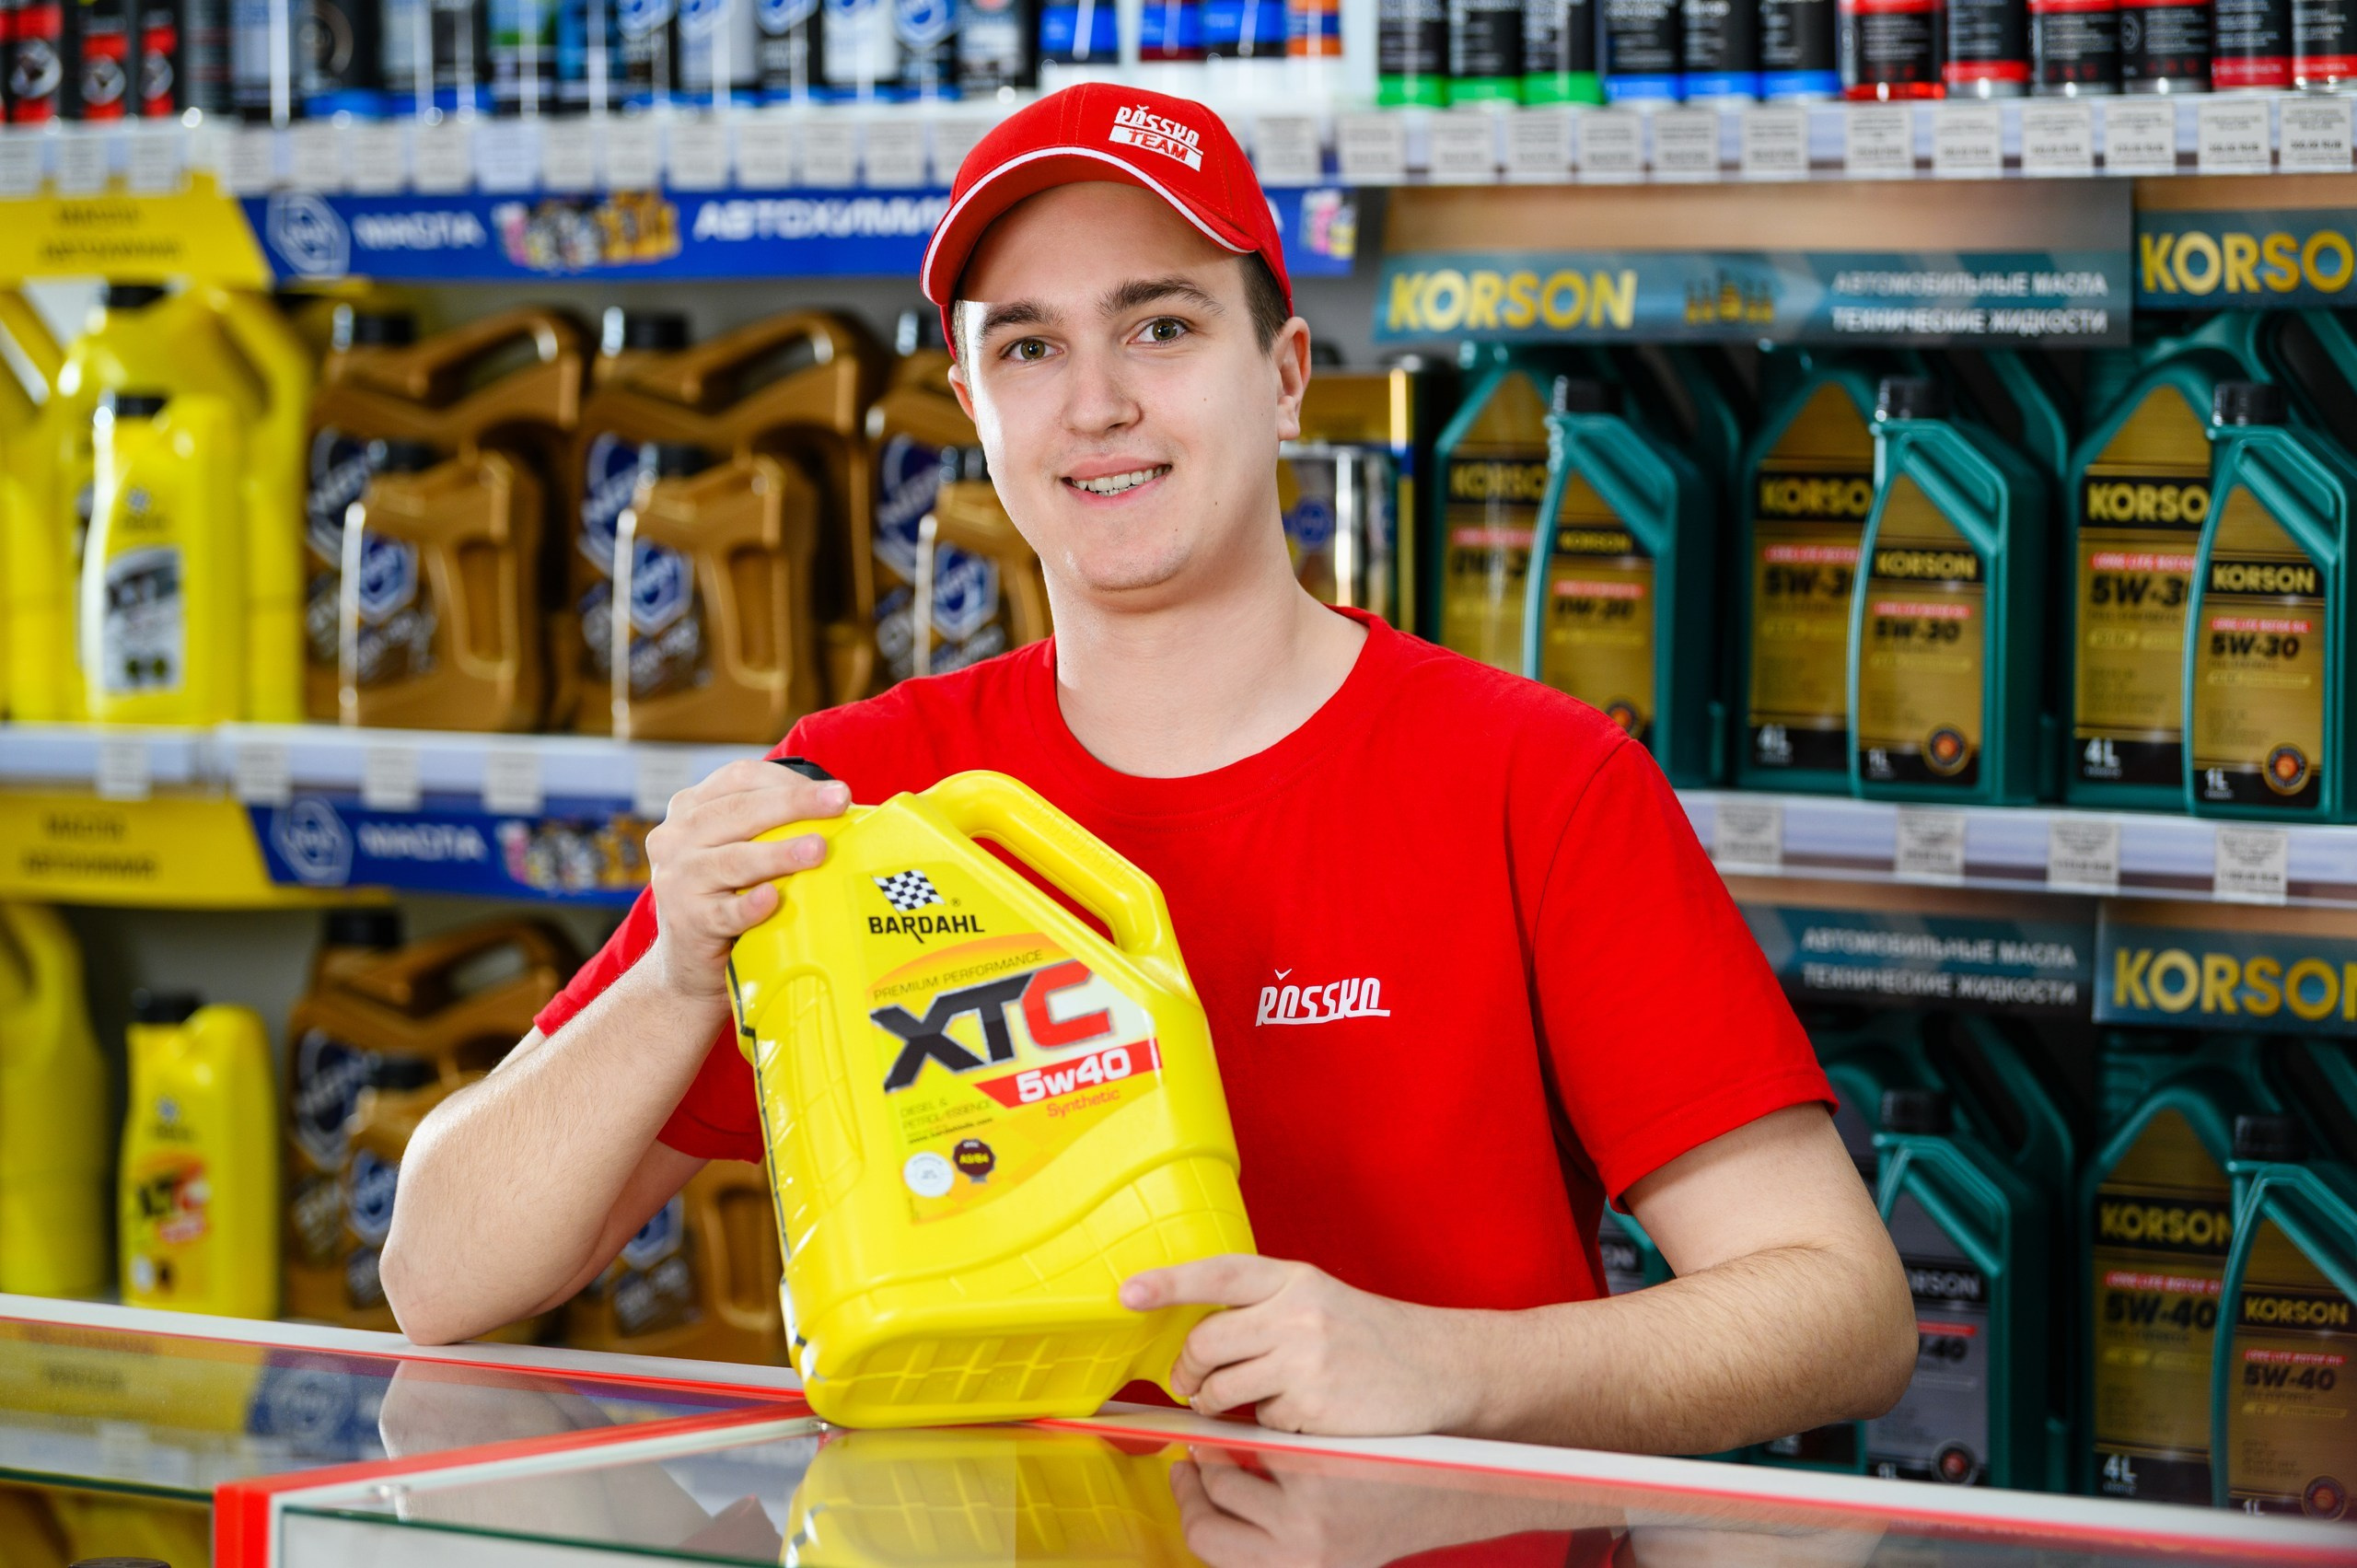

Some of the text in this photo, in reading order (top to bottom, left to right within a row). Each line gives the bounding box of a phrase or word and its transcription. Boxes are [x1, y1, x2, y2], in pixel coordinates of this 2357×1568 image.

[1129, 129, 1189, 161] TEAM
[2140, 229, 2356, 296] KORSO
[1387, 268, 1638, 332] KORSON
[1832, 272, 2108, 297] АВТОМОБИЛЬНЫЕ МАСЛА
[1831, 307, 2108, 337] ТЕХНИЧЕСКИЕ ЖИДКОСТИ
[1450, 465, 1550, 500] KORSO
[1761, 479, 1874, 517] KORSO
[2086, 482, 2211, 523] KORSO
[1876, 551, 1977, 580] KORSON
[2212, 564, 2316, 594] KORSON
[1765, 566, 1852, 598] 5W-3
[2091, 575, 2185, 606] 5W-3
[2212, 634, 2300, 659] 5W-30
[2084, 736, 2121, 768] 4L
[868, 914, 985, 944] BARDAHL
[1802, 927, 2077, 968] АВТОМОБИЛЬНЫЕ МАСЛА
[874, 948, 1043, 1001] PREMIUM PERFORMANCE
[1803, 963, 2078, 1005] ТЕХНИЧЕСКИЕ ЖИДКОСТИ
[2113, 947, 2357, 1021] KORSO
[869, 958, 1114, 1094] XTC
[1016, 1048, 1132, 1102] 5w40
[1047, 1088, 1120, 1119] Synthetic
[1908, 1270, 1980, 1299] RSON
[2105, 1293, 2217, 1332] 5W-40
[2245, 1296, 2349, 1325] KORSON
[2244, 1364, 2336, 1391] 5W-40
[2103, 1454, 2138, 1484] 4L
